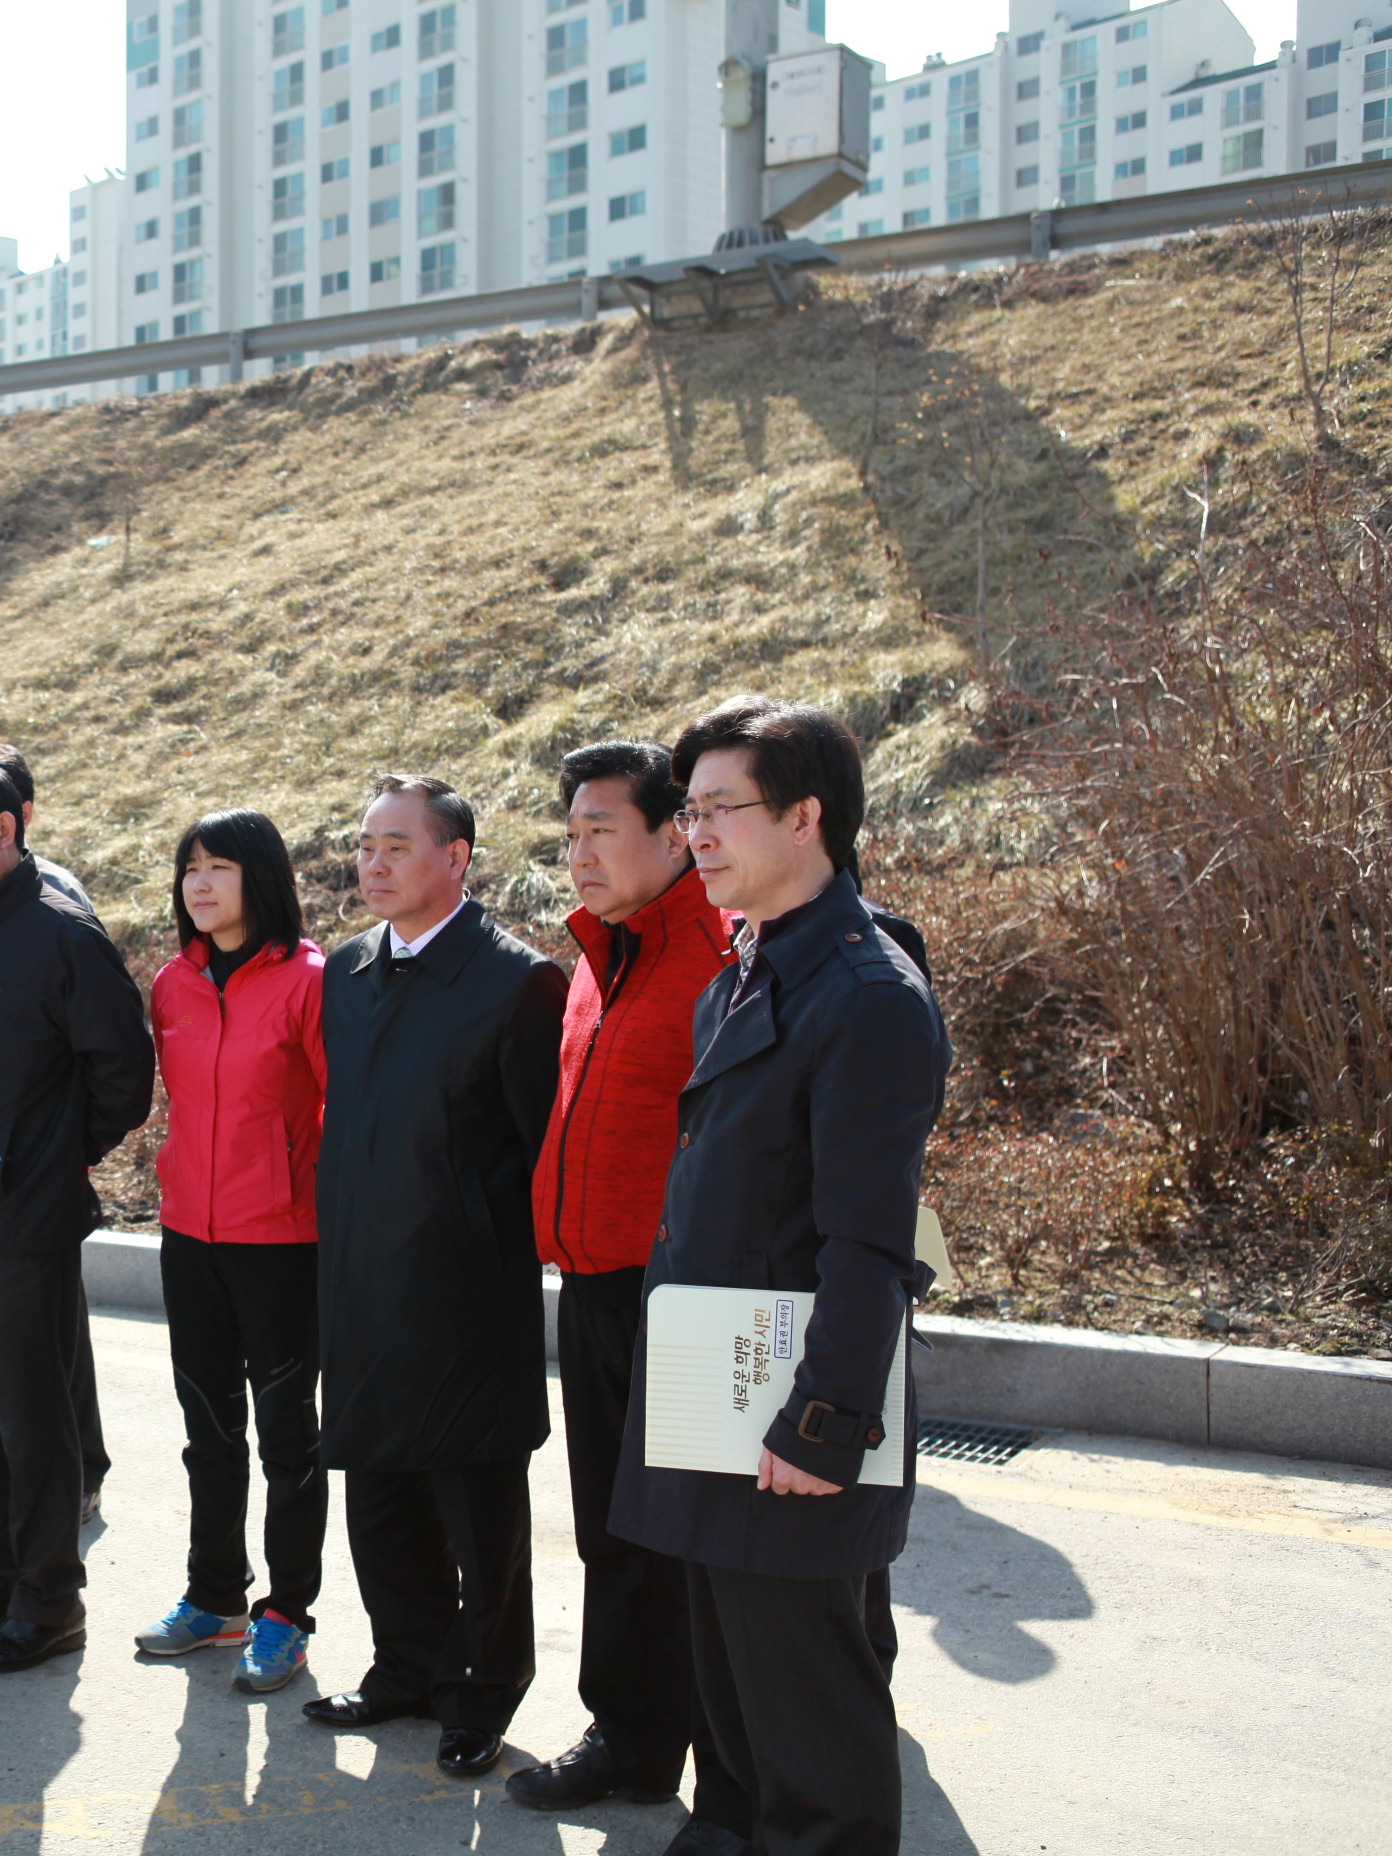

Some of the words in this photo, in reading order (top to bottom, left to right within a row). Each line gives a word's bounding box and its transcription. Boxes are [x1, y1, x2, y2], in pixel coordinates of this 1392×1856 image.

[754, 1308, 771, 1339] 시민
[779, 1303, 790, 1328] 부의장
[734, 1334, 751, 1366] 희망
[752, 1340, 770, 1385] 행복한
[733, 1369, 750, 1413] 새로운
